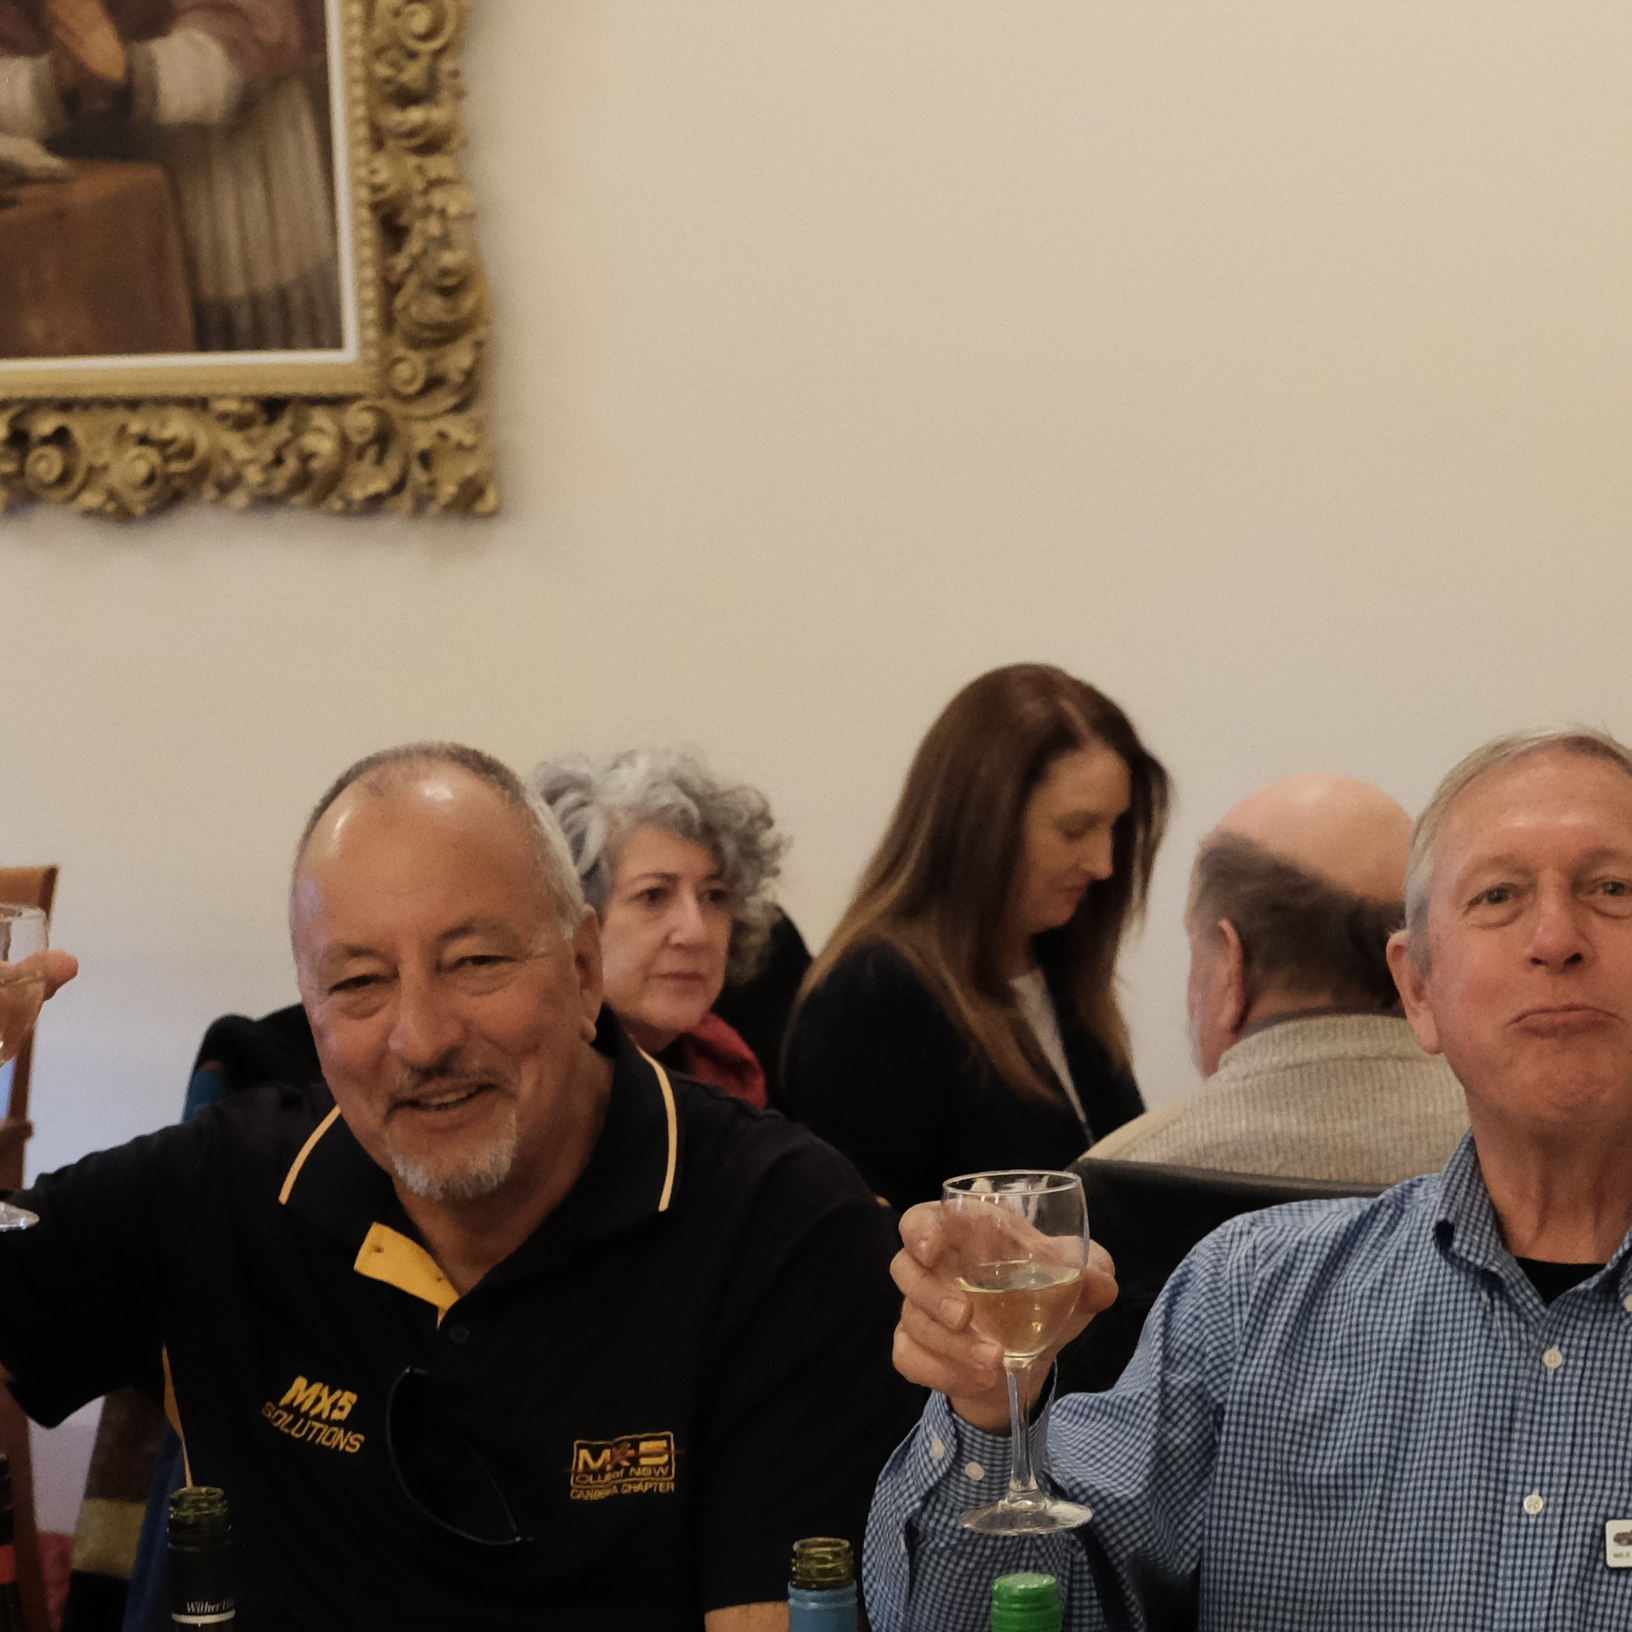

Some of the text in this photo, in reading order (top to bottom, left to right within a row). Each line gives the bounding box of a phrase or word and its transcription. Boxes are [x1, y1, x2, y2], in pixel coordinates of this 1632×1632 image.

[278, 1375, 358, 1422] MX5
[261, 1401, 365, 1453] SOLUTIONS
[629, 1465, 669, 1477] NSW
[620, 1481, 675, 1494] CHAPTER
